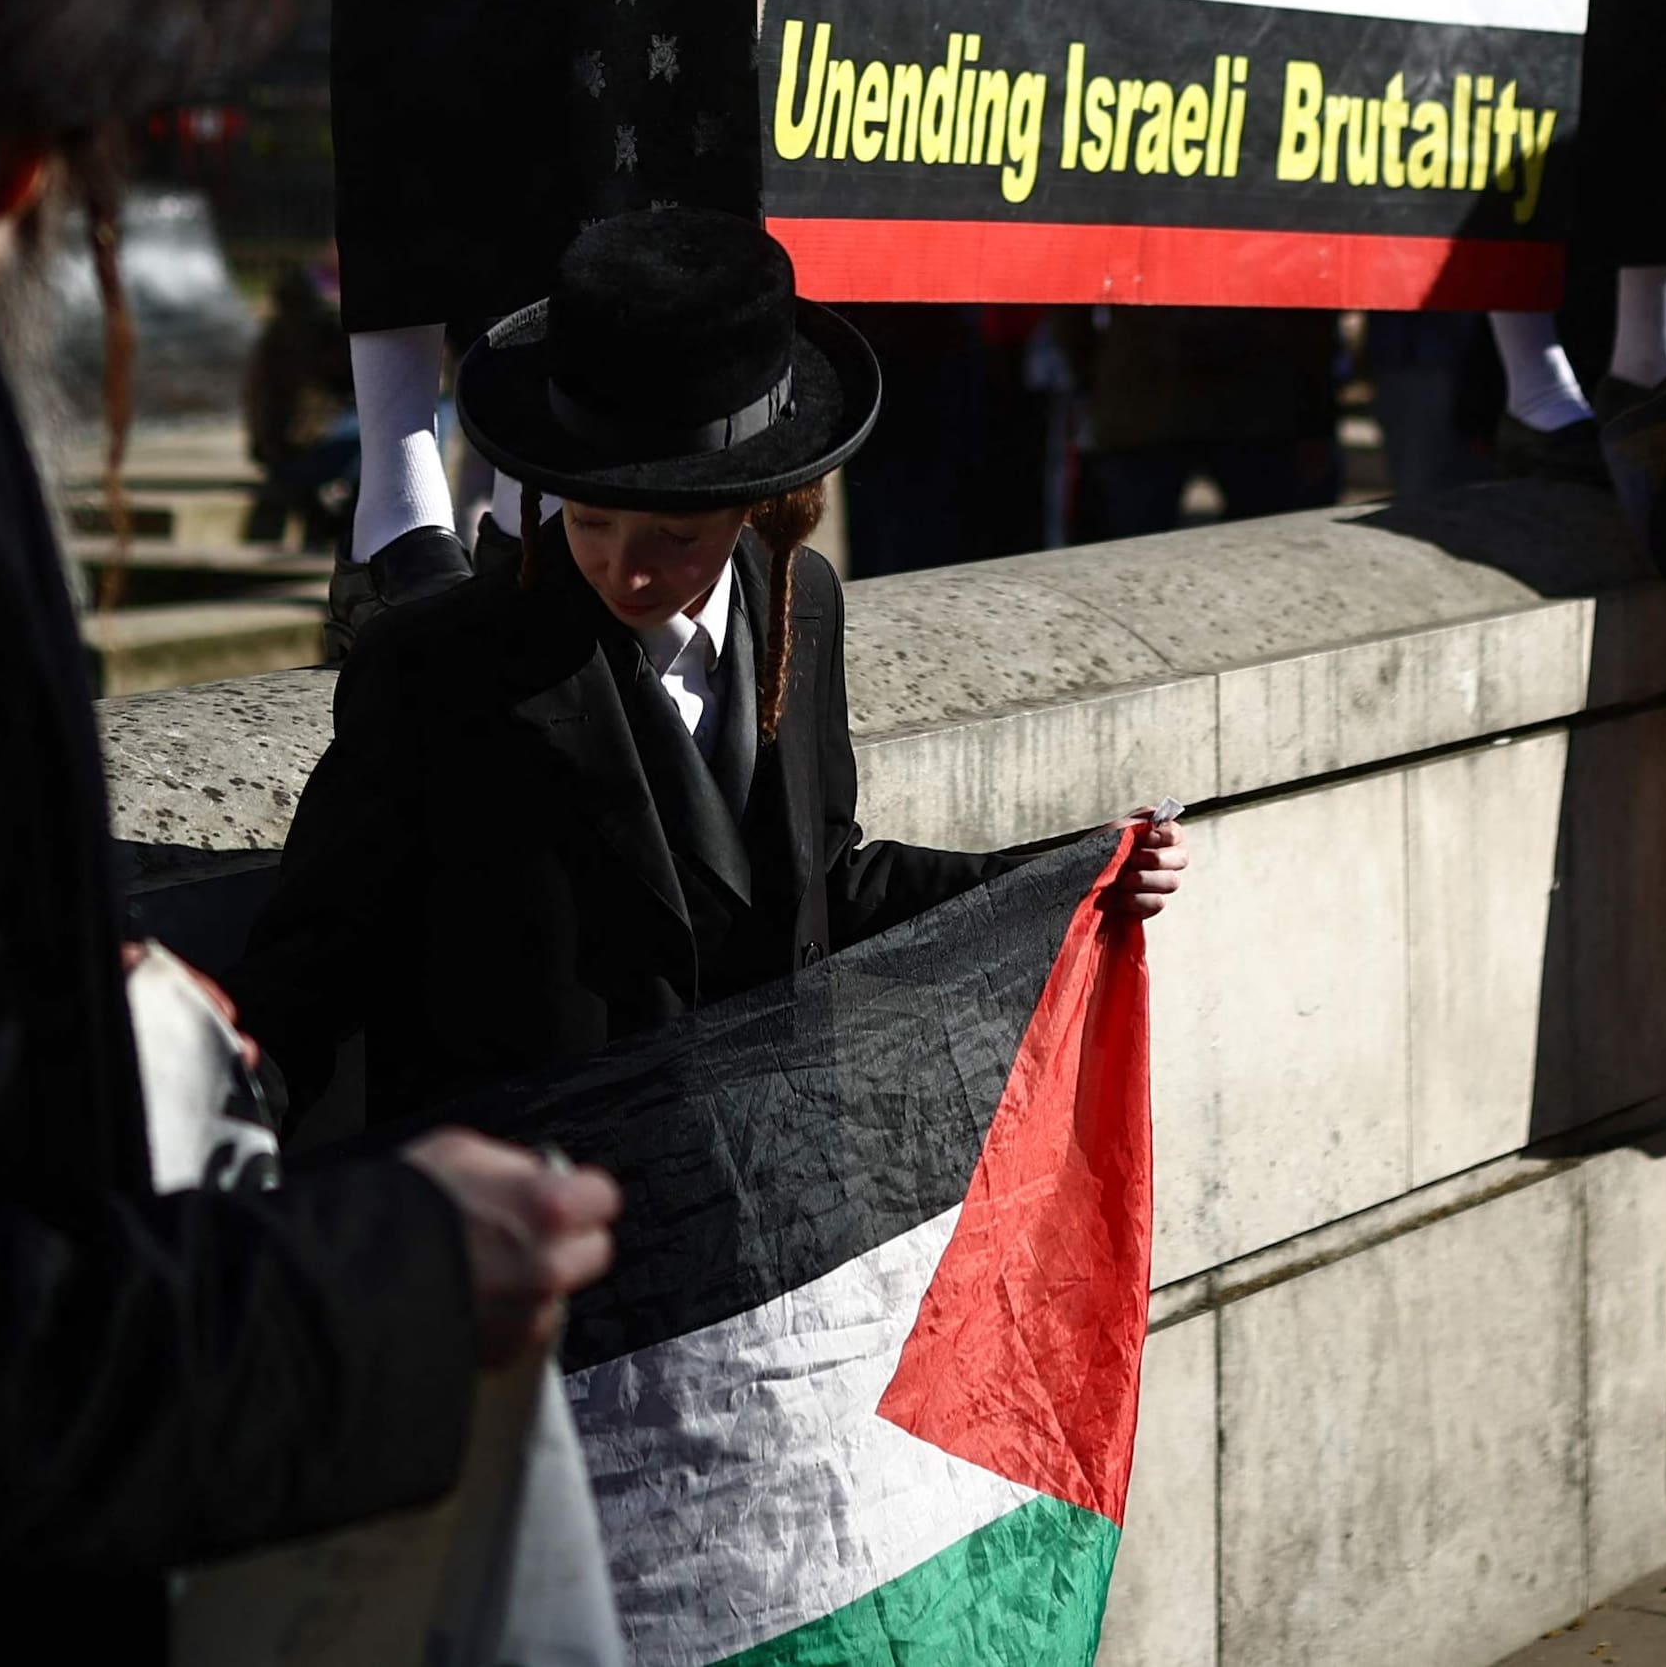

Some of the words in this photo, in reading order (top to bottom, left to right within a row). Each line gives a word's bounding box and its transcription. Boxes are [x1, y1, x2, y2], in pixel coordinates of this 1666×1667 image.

[772, 18, 1045, 204] Unending
[1062, 41, 1249, 178] Israeli
[1275, 59, 1558, 223] Brutality
